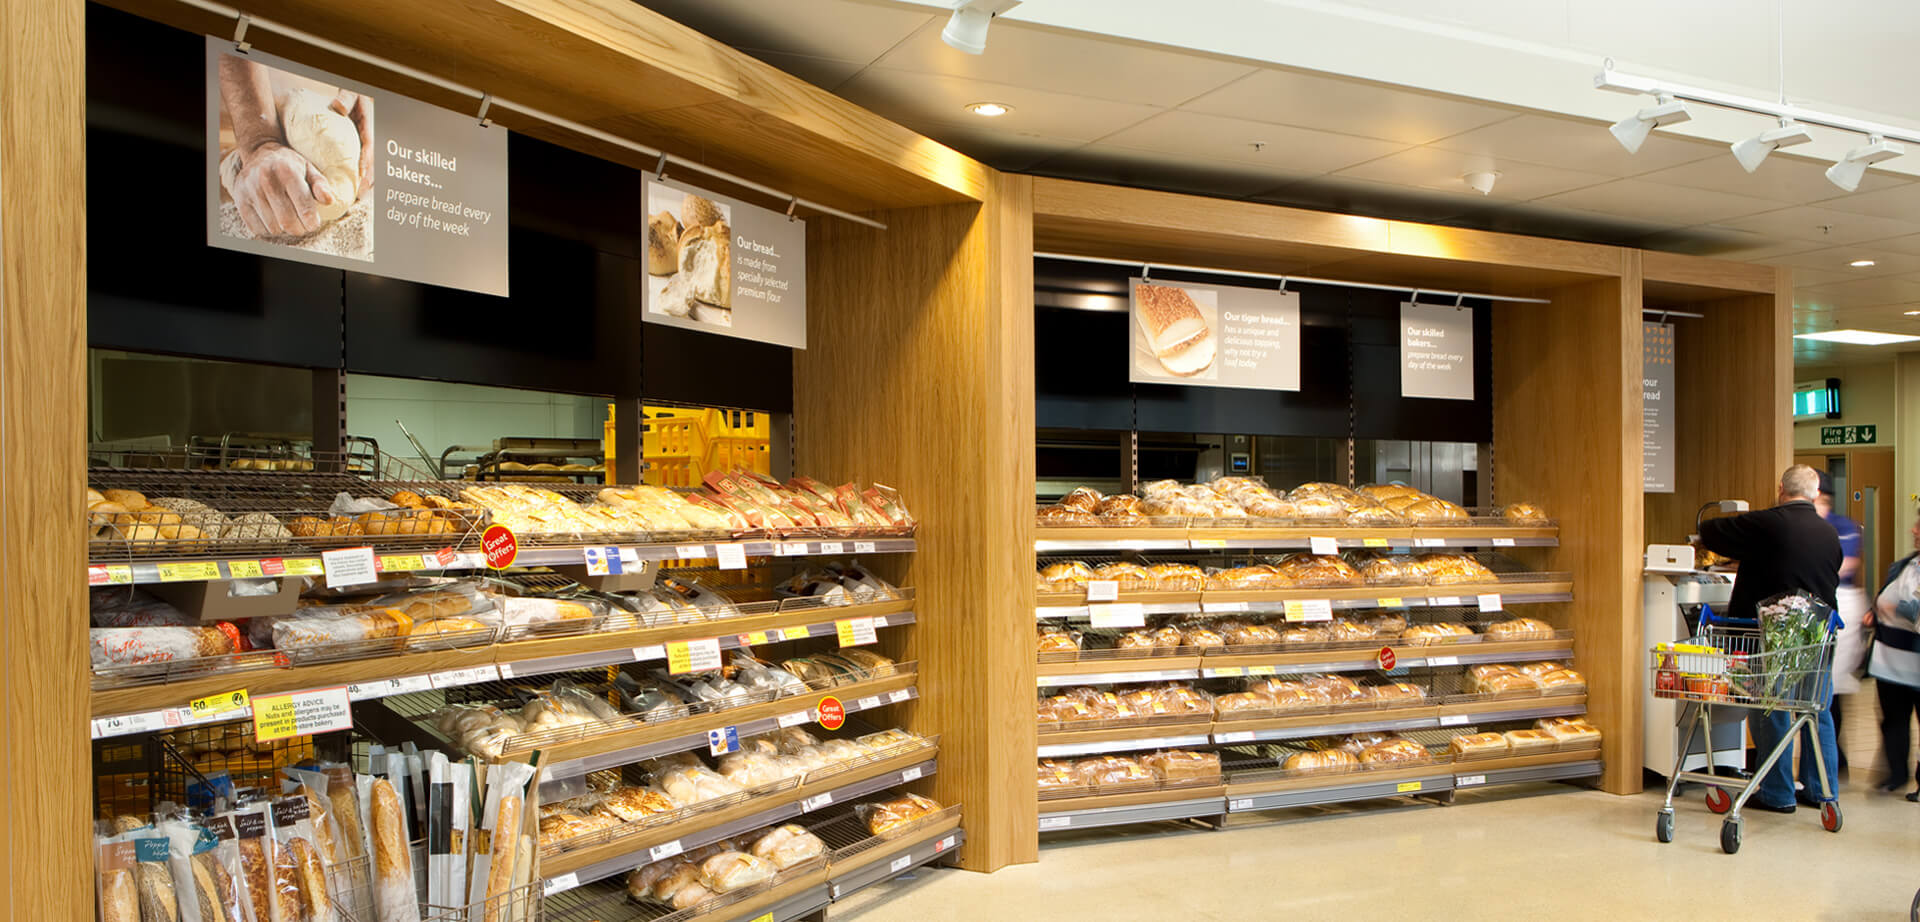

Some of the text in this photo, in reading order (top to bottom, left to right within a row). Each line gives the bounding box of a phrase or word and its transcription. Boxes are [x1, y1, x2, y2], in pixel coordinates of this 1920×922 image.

[387, 140, 456, 172] Our skilled
[386, 188, 492, 225] prepare bread every
[386, 206, 470, 237] day of the week
[736, 235, 752, 250] Our
[743, 258, 762, 270] made
[762, 259, 777, 273] from
[736, 271, 788, 291] specially selected
[736, 286, 782, 303] premium flour
[1224, 311, 1240, 321] Our
[1241, 312, 1260, 325] tiger
[1224, 324, 1237, 334] has
[1243, 327, 1265, 338] unique
[1266, 328, 1280, 337] and
[1408, 326, 1445, 338] Our skilled
[1408, 351, 1464, 364] prepare bread every
[1239, 359, 1256, 371] today
[1408, 360, 1418, 370] day
[1436, 362, 1452, 371] week
[1824, 428, 1842, 437] Fire
[1824, 436, 1841, 444] exit
[486, 532, 508, 551] Great
[489, 543, 514, 562] Offers
[96, 638, 145, 663] Tiger
[272, 698, 324, 711] ALLERGY ADVICE
[822, 705, 840, 713] Great
[259, 720, 283, 728] present
[291, 715, 317, 724] products
[318, 710, 346, 720] purchased
[265, 712, 280, 720] Nuts
[294, 708, 320, 716] allergens
[822, 713, 842, 721] Offers
